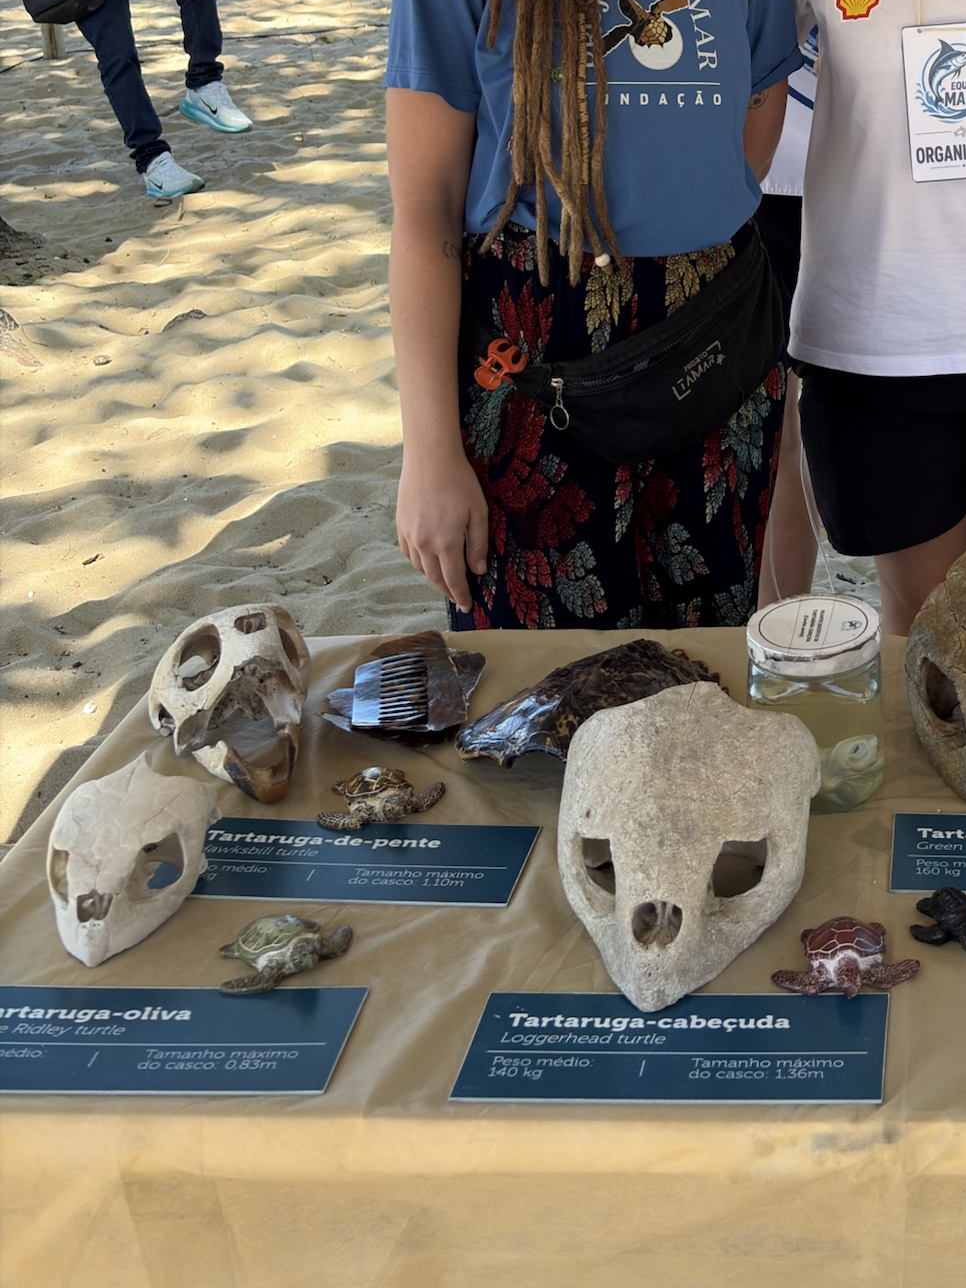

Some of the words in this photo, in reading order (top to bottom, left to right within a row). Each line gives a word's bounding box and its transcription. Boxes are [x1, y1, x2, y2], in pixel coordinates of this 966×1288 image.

[603, 90, 722, 109] NDAÇÃO
[683, 350, 709, 372] PROJETO
[676, 353, 715, 391] TAMAR
[207, 829, 441, 850] Tartaruga-de-pente
[275, 847, 319, 858] turtle
[916, 841, 963, 852] Green
[220, 863, 272, 874] médio:
[916, 859, 949, 869] Peso
[354, 868, 423, 879] Tamanho
[425, 869, 485, 880] máximo
[916, 867, 941, 876] 160
[944, 867, 961, 878] kg
[348, 875, 369, 886] do
[371, 877, 416, 887] casco:
[508, 1011, 791, 1033] Tartaruga-cabeçuda
[12, 1023, 70, 1038] Ridley
[75, 1024, 126, 1037] turtle
[500, 1032, 612, 1047] Loggerhead
[617, 1033, 667, 1046] turtle
[146, 1048, 225, 1060] Tamanho
[229, 1048, 299, 1060] máximo
[137, 1059, 161, 1071] do
[164, 1061, 219, 1071] casco:
[224, 1059, 278, 1072] 0,83m
[492, 1056, 532, 1067] Peso
[536, 1055, 595, 1068] médio:
[691, 1057, 773, 1069] Tamanho
[777, 1057, 845, 1069] máximo
[487, 1067, 521, 1078] 140
[523, 1067, 543, 1080] kg
[688, 1068, 713, 1080] do
[716, 1069, 770, 1080] casco:
[775, 1068, 825, 1080] 1,36m
